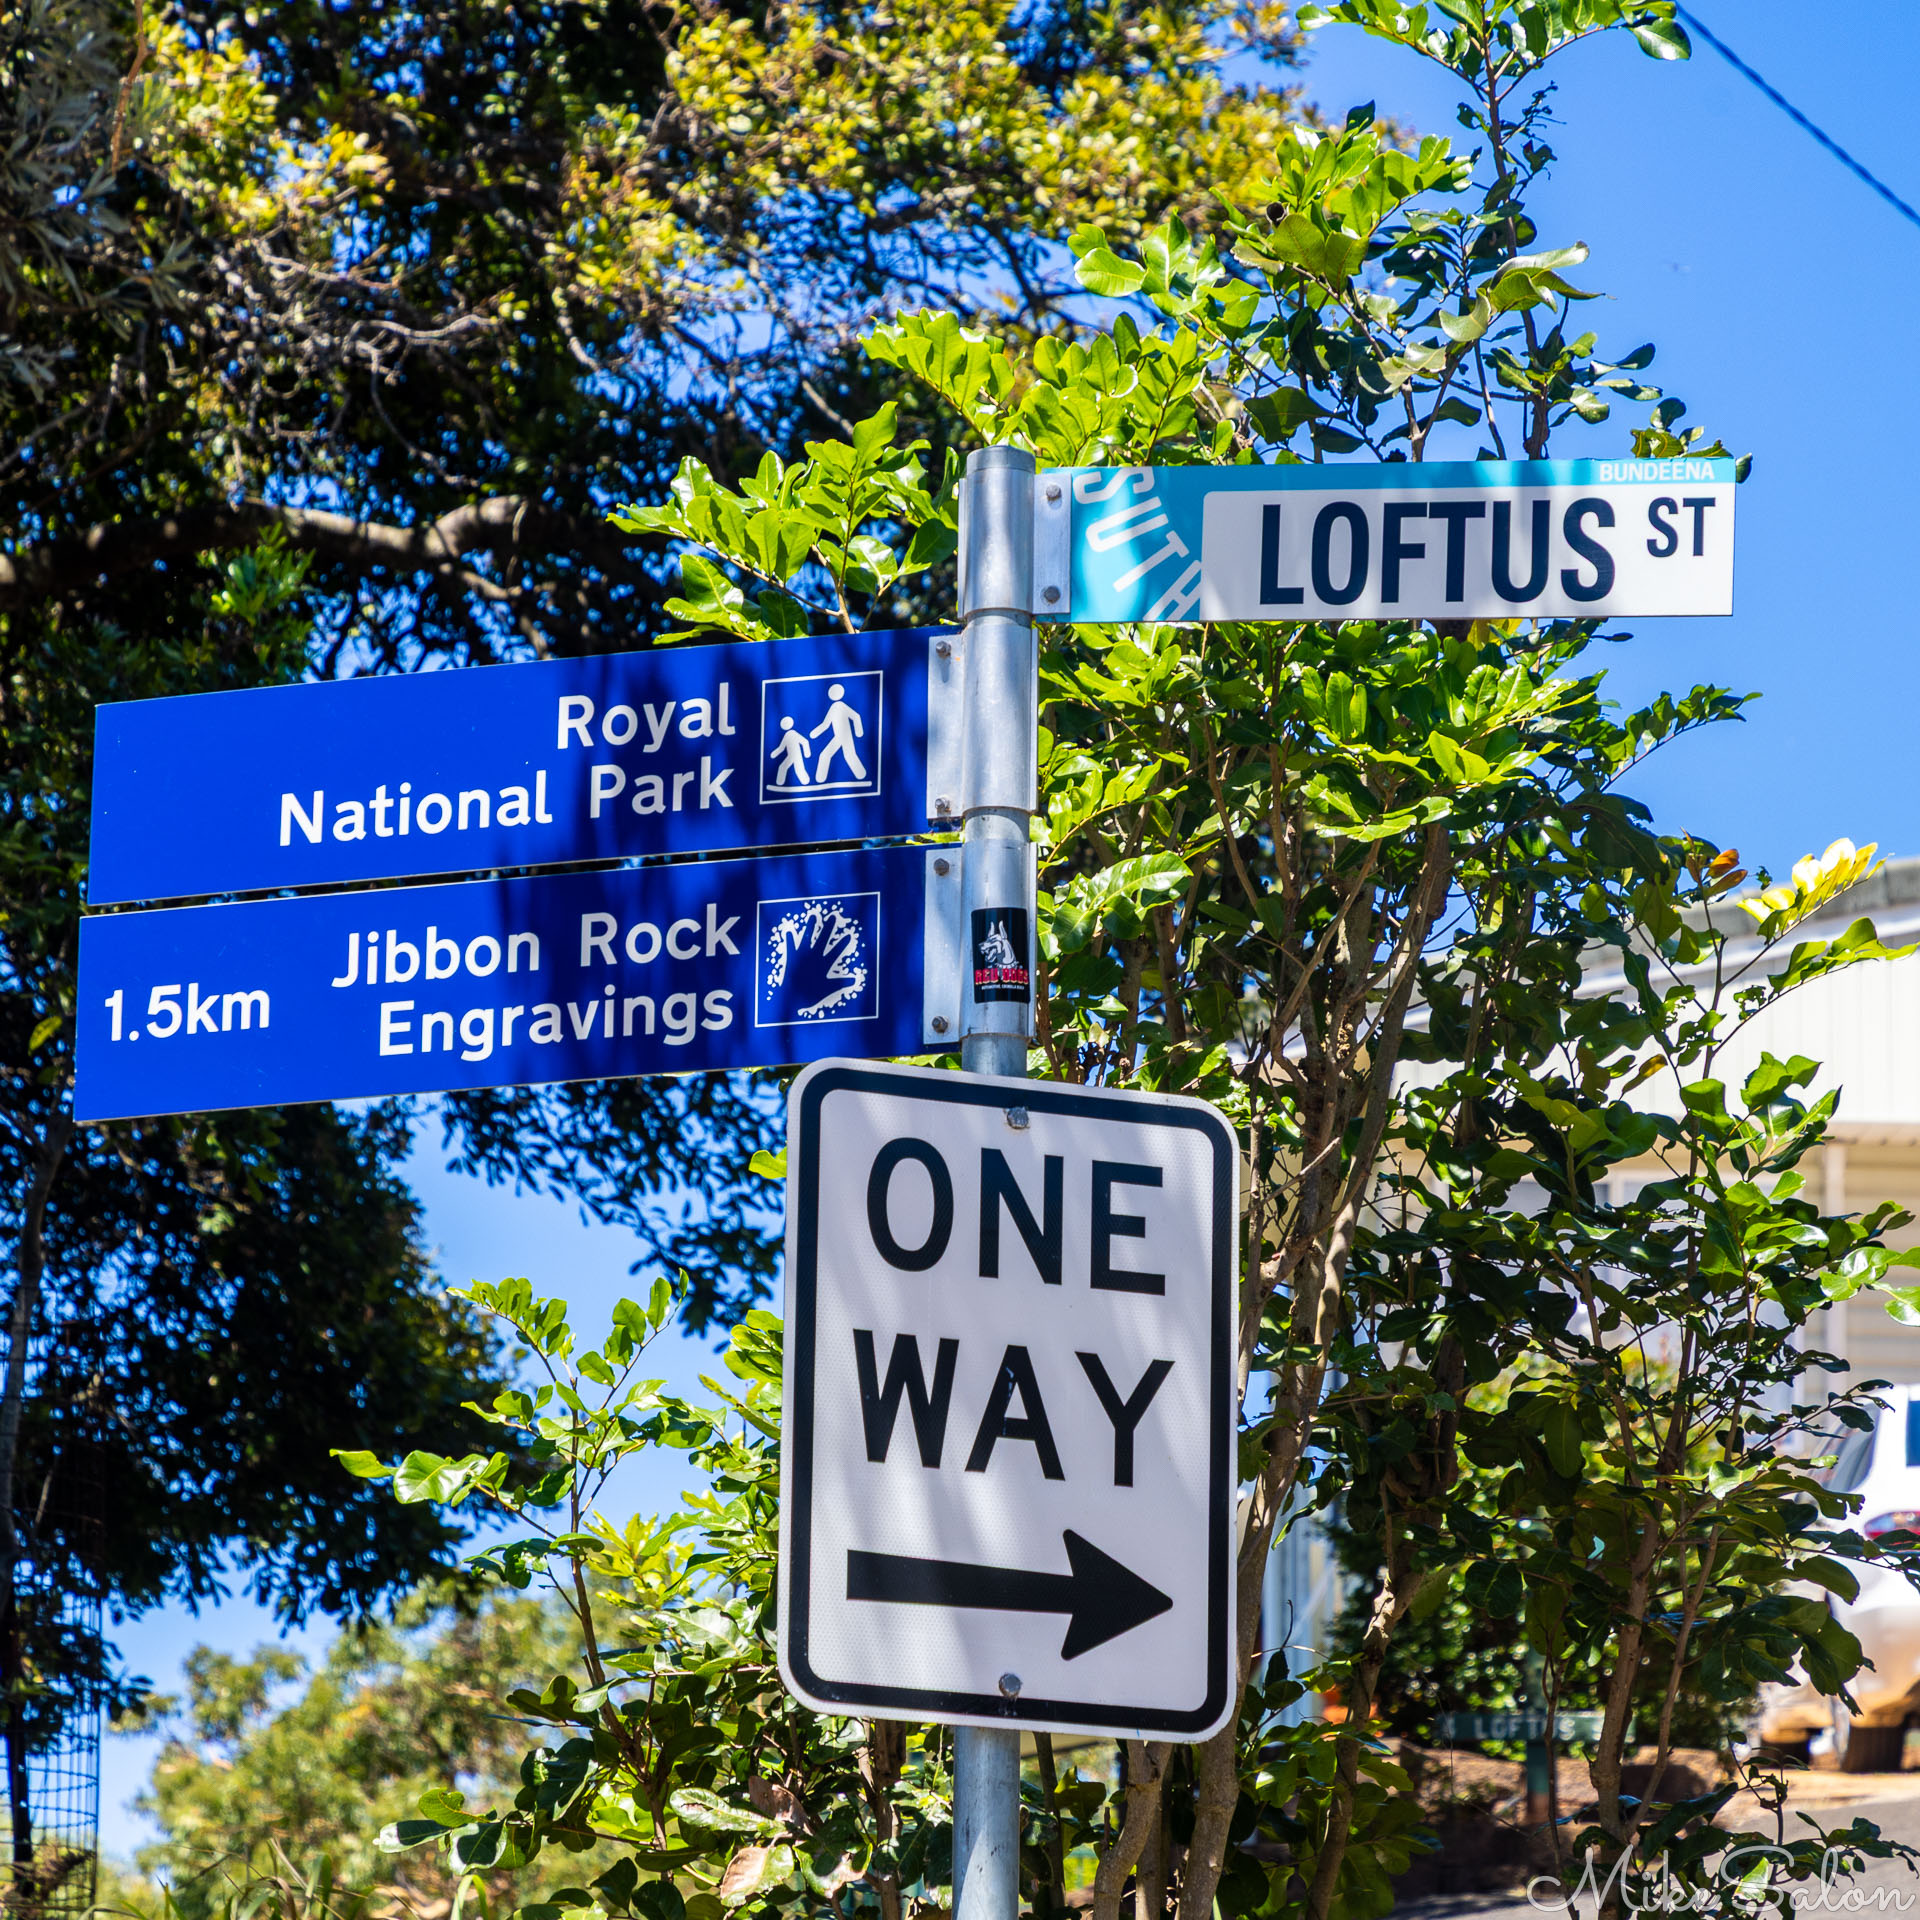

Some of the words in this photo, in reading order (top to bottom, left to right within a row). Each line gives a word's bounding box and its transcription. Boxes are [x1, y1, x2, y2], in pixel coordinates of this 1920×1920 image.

[1600, 461, 1715, 482] BUNDEENA
[1259, 497, 1616, 606] LOFTUS
[1647, 497, 1716, 558] ST
[558, 682, 735, 752] Royal
[280, 770, 552, 846] National
[591, 756, 734, 818] Park
[332, 926, 539, 987] Jibbon
[581, 903, 740, 966] Rock
[105, 983, 270, 1041] 1.5km
[380, 984, 733, 1061] Engravings
[867, 1138, 1165, 1296] ONE
[853, 1329, 1174, 1487] WAY
